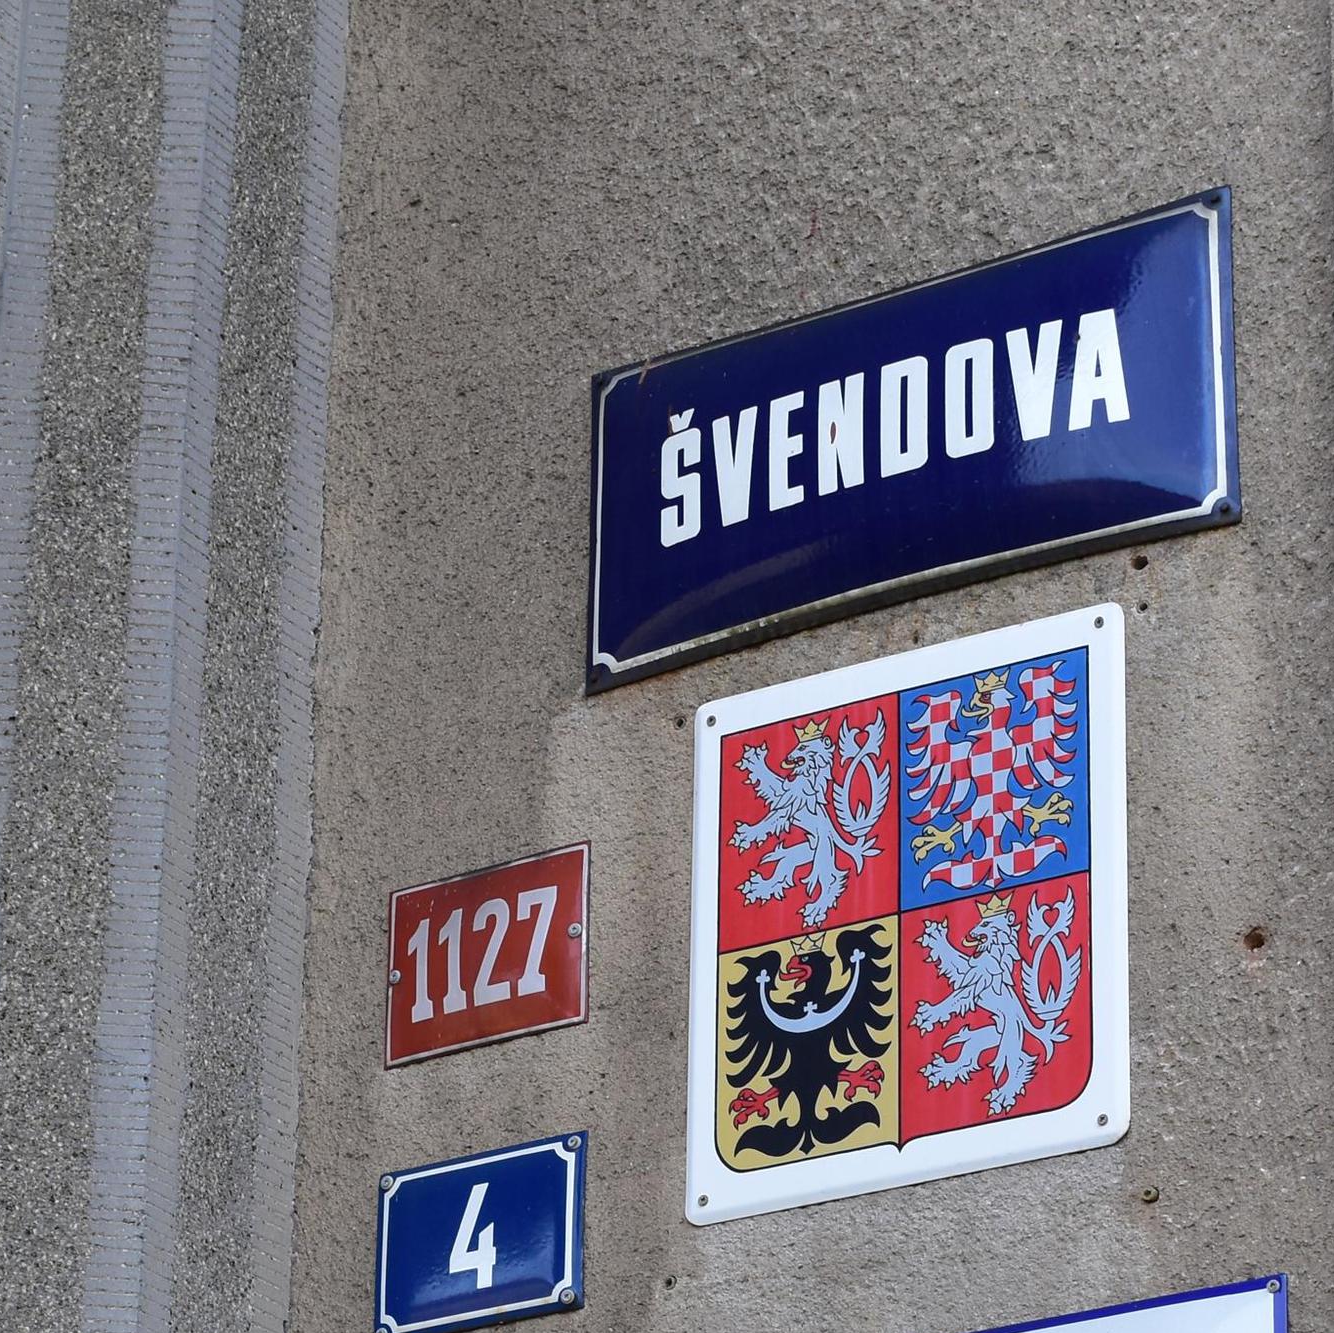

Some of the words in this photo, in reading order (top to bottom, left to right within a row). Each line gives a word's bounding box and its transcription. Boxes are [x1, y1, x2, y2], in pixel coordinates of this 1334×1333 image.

[660, 307, 1131, 548] ŠVENDOVA
[407, 884, 558, 1024] 1127
[448, 1182, 497, 1290] 4
